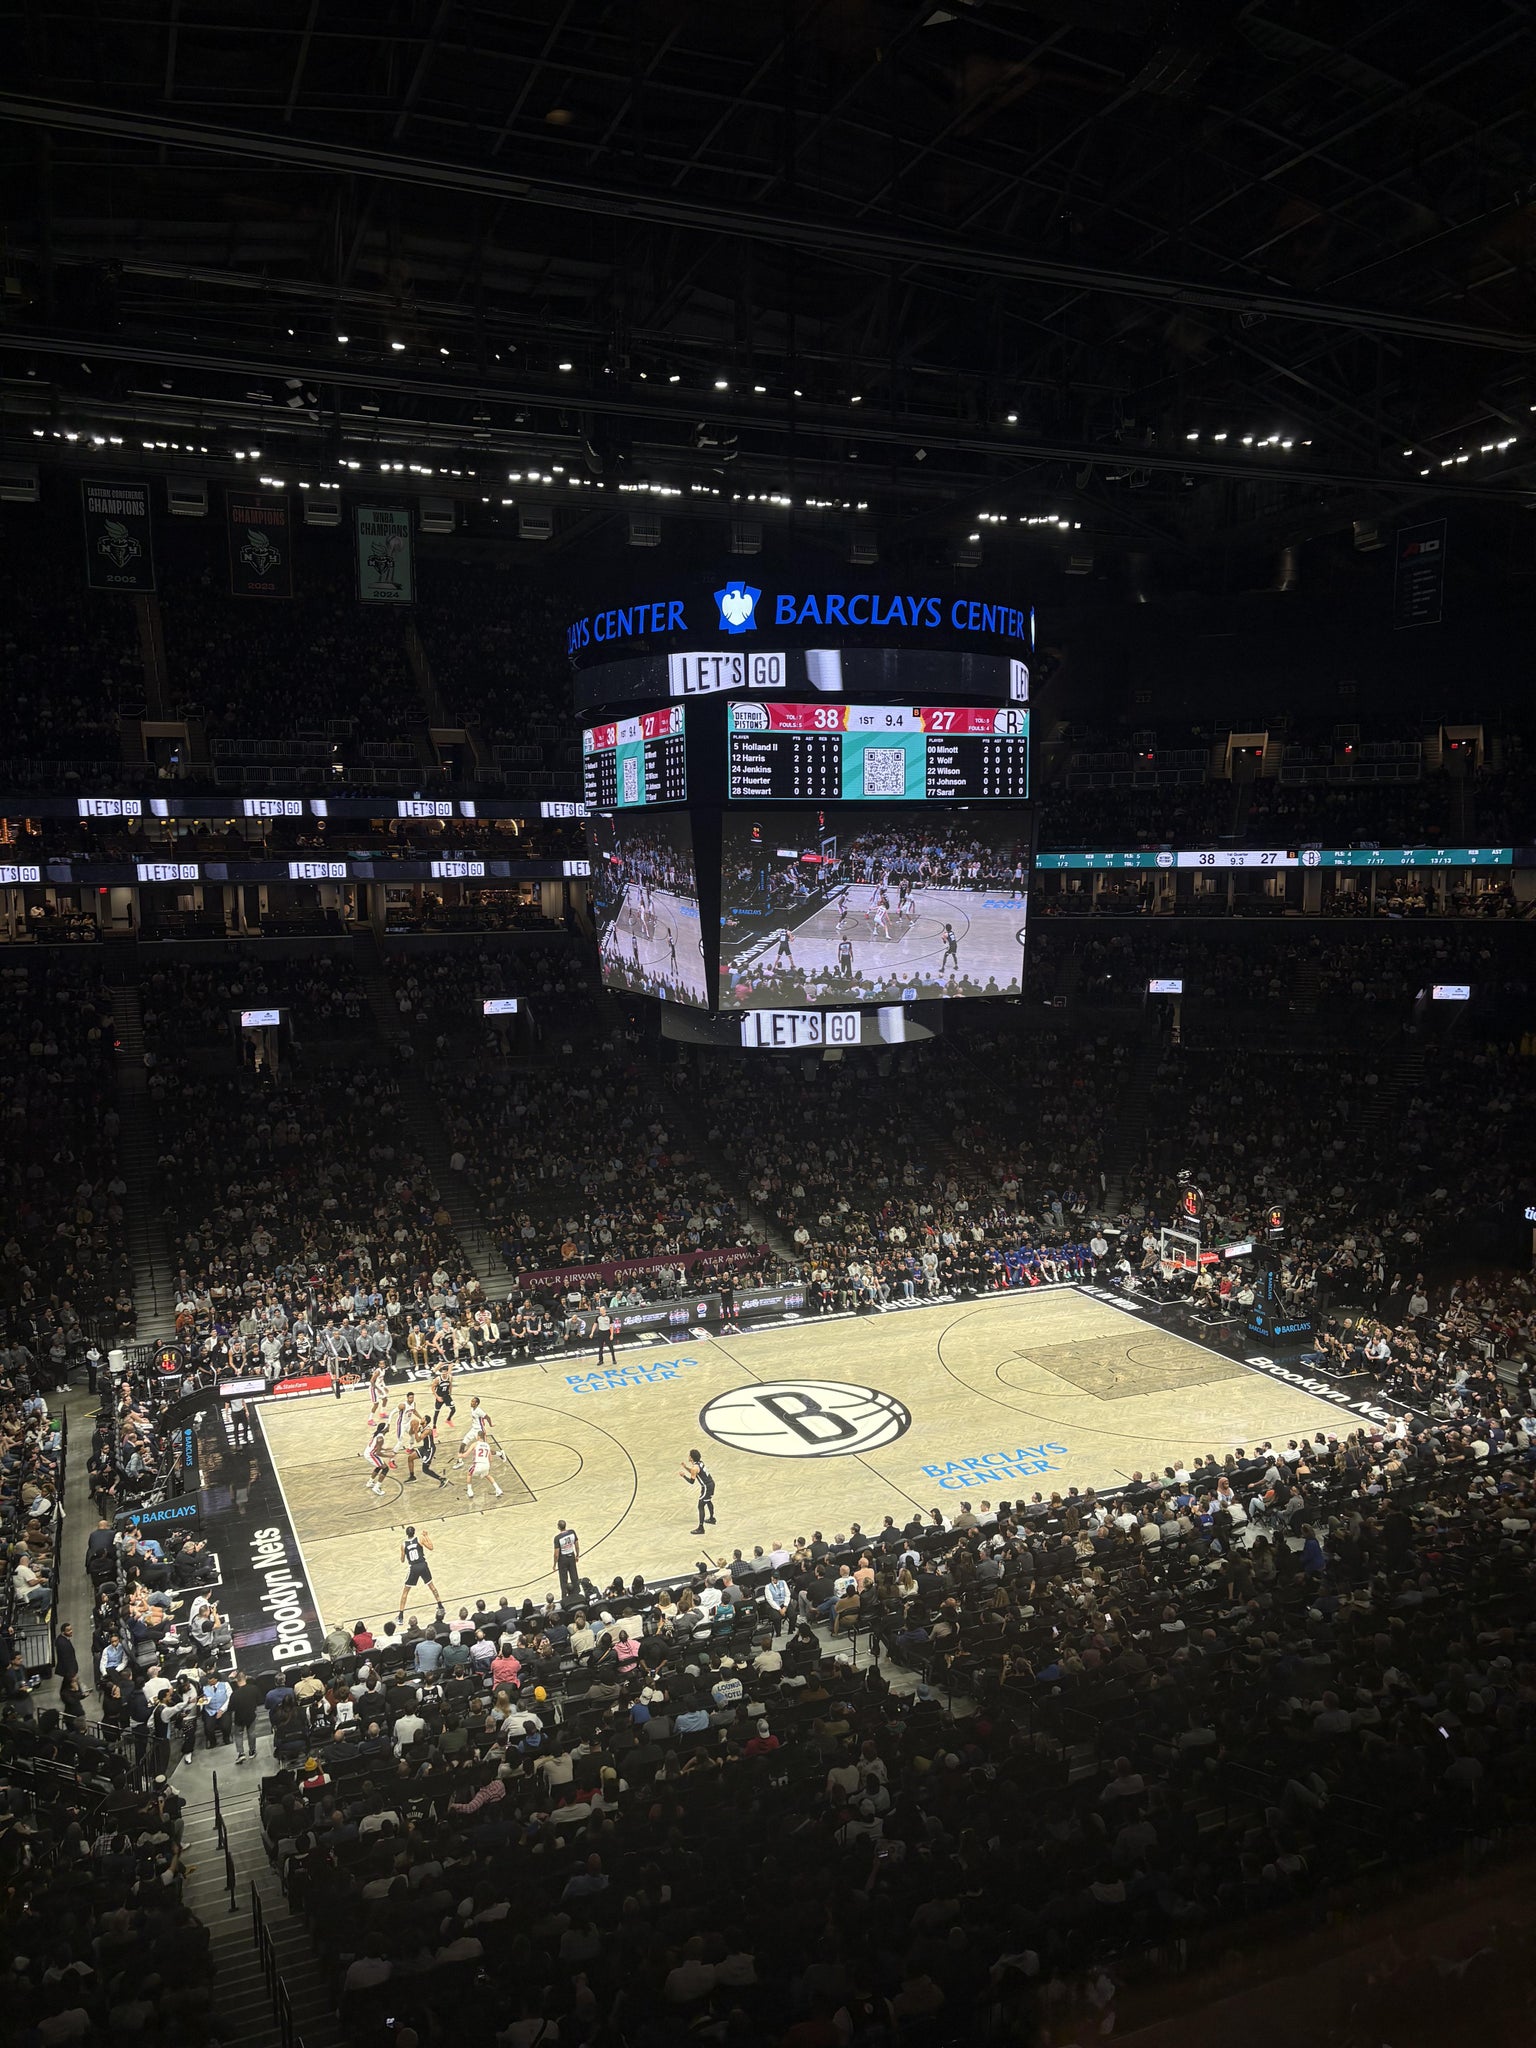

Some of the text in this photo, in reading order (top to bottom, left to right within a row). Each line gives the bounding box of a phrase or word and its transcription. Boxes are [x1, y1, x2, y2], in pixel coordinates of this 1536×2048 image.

[88, 499, 145, 516] CHAMPIONS
[232, 508, 286, 526] CHAMPIONS
[373, 512, 393, 523] WNBA
[360, 522, 408, 538] CHAMPIONS
[106, 574, 137, 584] 2002
[374, 590, 399, 598] 2024
[594, 600, 688, 642] CENTER
[774, 594, 1025, 640] BARCLAYS CENTER
[682, 656, 780, 693] LET'S GO
[735, 712, 762, 720] DETROIT
[814, 708, 839, 728] 38
[859, 716, 874, 725] 1ST
[886, 714, 903, 726] 9.4
[932, 712, 956, 730] 27
[645, 717, 655, 736] 27
[735, 720, 762, 729] PISTONS
[86, 801, 140, 815] LET'S GO
[250, 801, 300, 815] LET'S GO
[406, 801, 450, 816] LET'S GO
[547, 802, 574, 816] LET'S
[1199, 854, 1215, 864] 38
[1260, 854, 1277, 864] 27
[0, 867, 37, 880] T'S GO
[146, 865, 196, 880] LET'S GO
[299, 863, 344, 878] LET'S GO
[438, 863, 482, 876] LET'S GO
[756, 1012, 856, 1046] LET'S GO
[530, 1272, 598, 1286] QATR AIRWAY
[1281, 1322, 1311, 1333] BARCLAYS
[565, 1358, 699, 1384] BARCLAYS
[572, 1370, 684, 1394] CENTER
[1245, 1357, 1351, 1402] Brooklyn
[753, 1392, 858, 1445] B
[478, 1449, 489, 1458] 27
[920, 1442, 1068, 1478] BARCLAYS
[938, 1460, 1061, 1489] CENTER
[142, 1505, 196, 1523] BARCLAYS
[250, 1527, 313, 1661] Brooklyn Nets
